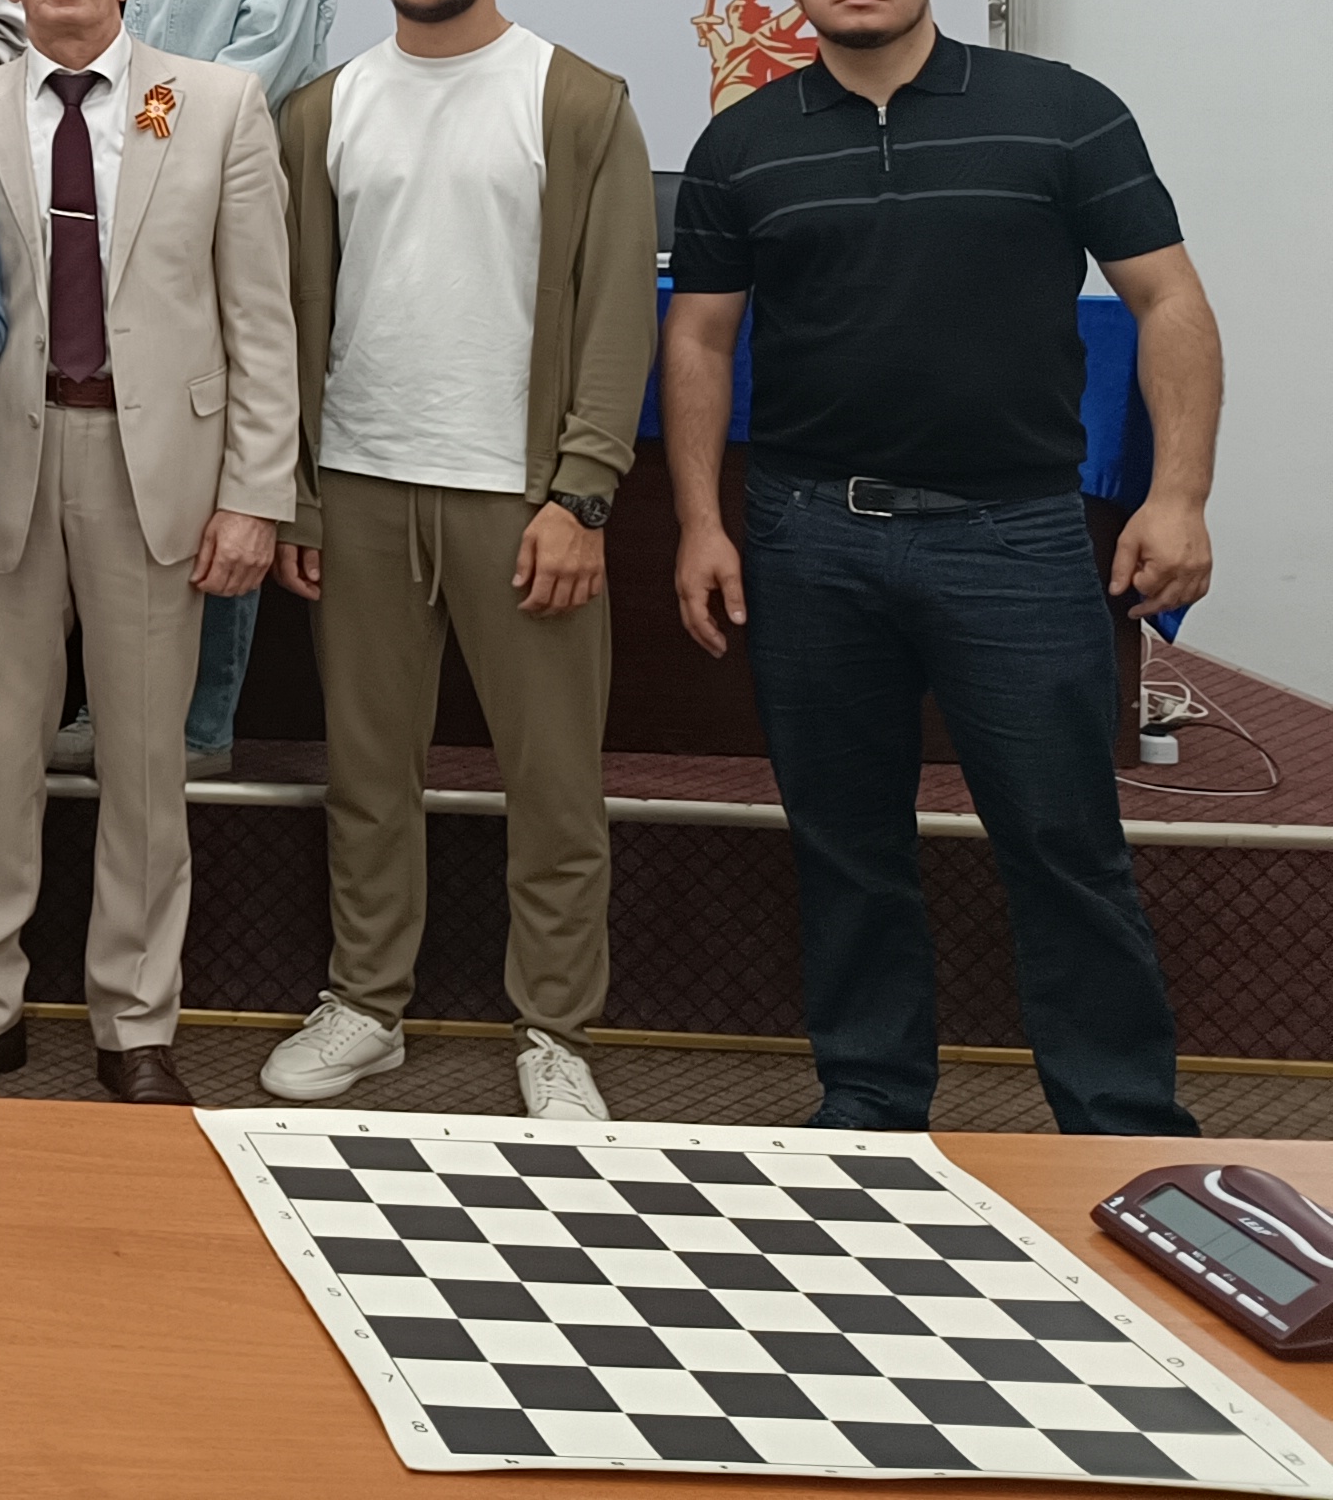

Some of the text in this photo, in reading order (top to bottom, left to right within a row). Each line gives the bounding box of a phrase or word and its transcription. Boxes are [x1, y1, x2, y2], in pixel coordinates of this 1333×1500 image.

[1237, 1216, 1273, 1237] LEAP
[1018, 1235, 1036, 1247] 3
[1113, 1313, 1133, 1326] 5
[326, 1286, 342, 1298] 5
[410, 1420, 429, 1434] 8
